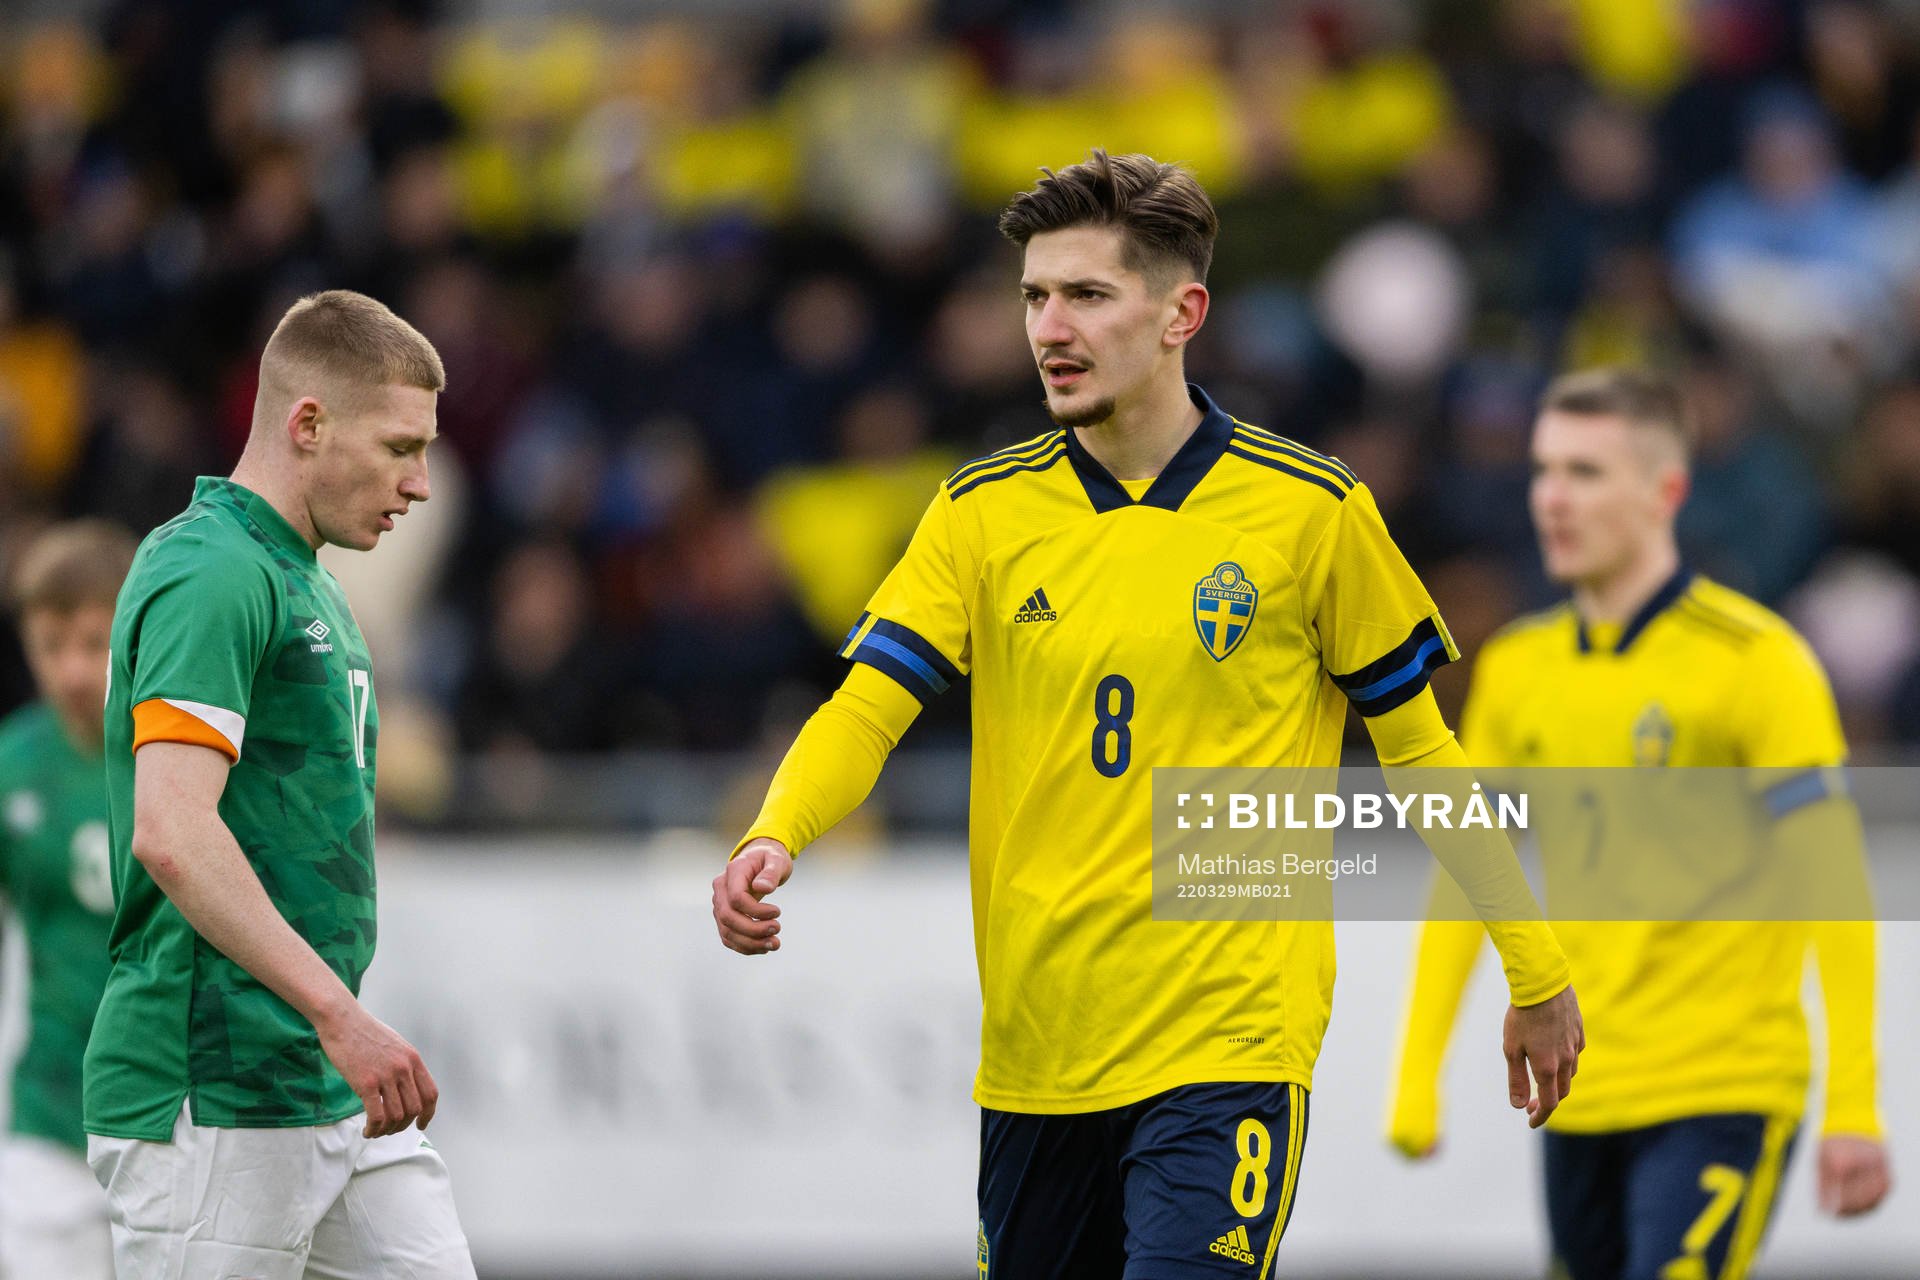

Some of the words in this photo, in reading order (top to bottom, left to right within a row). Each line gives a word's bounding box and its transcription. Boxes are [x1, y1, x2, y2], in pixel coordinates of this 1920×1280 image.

[1014, 606, 1057, 624] adidas
[1205, 589, 1247, 601] SVERIGE
[310, 642, 333, 653] umbro
[347, 669, 370, 769] 17
[1091, 673, 1135, 778] 8
[1230, 1118, 1272, 1217] 8
[1683, 1164, 1746, 1253] 7
[1209, 1240, 1256, 1265] adidas
